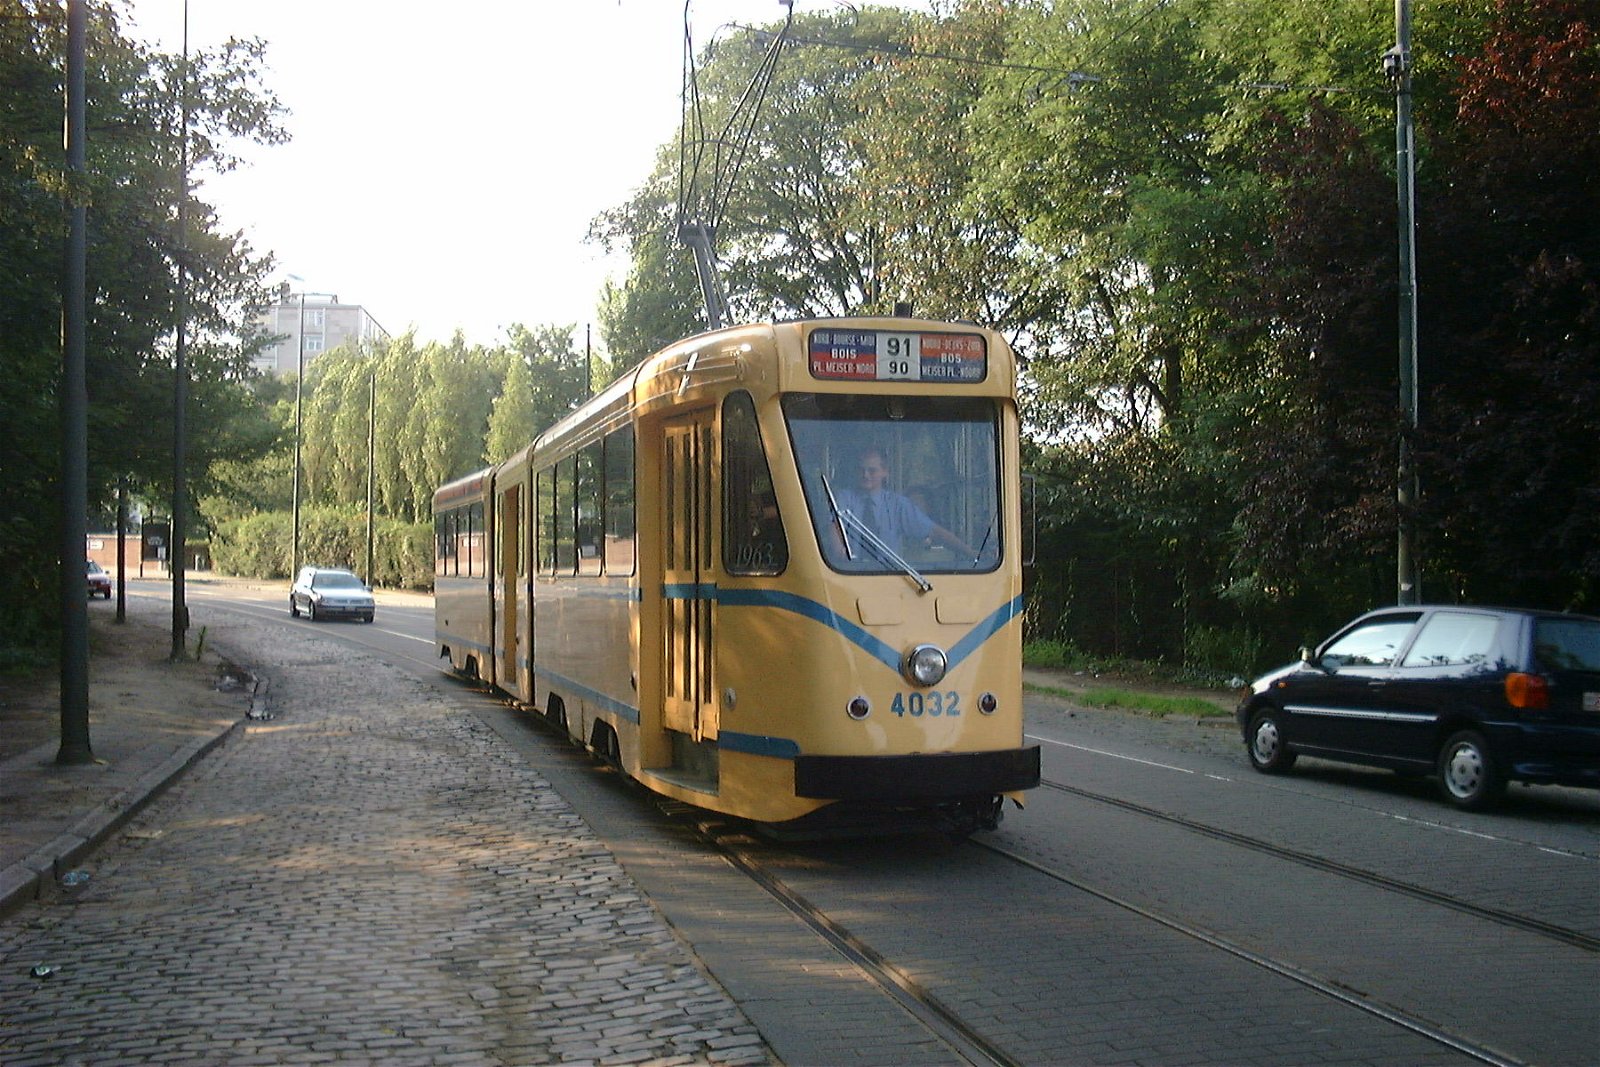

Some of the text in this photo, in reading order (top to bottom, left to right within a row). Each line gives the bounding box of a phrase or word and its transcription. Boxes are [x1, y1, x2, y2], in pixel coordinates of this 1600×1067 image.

[831, 347, 857, 360] BOIS
[887, 338, 910, 357] 91
[941, 353, 962, 364] BOS
[889, 361, 909, 375] 90
[890, 690, 961, 718] 4032
